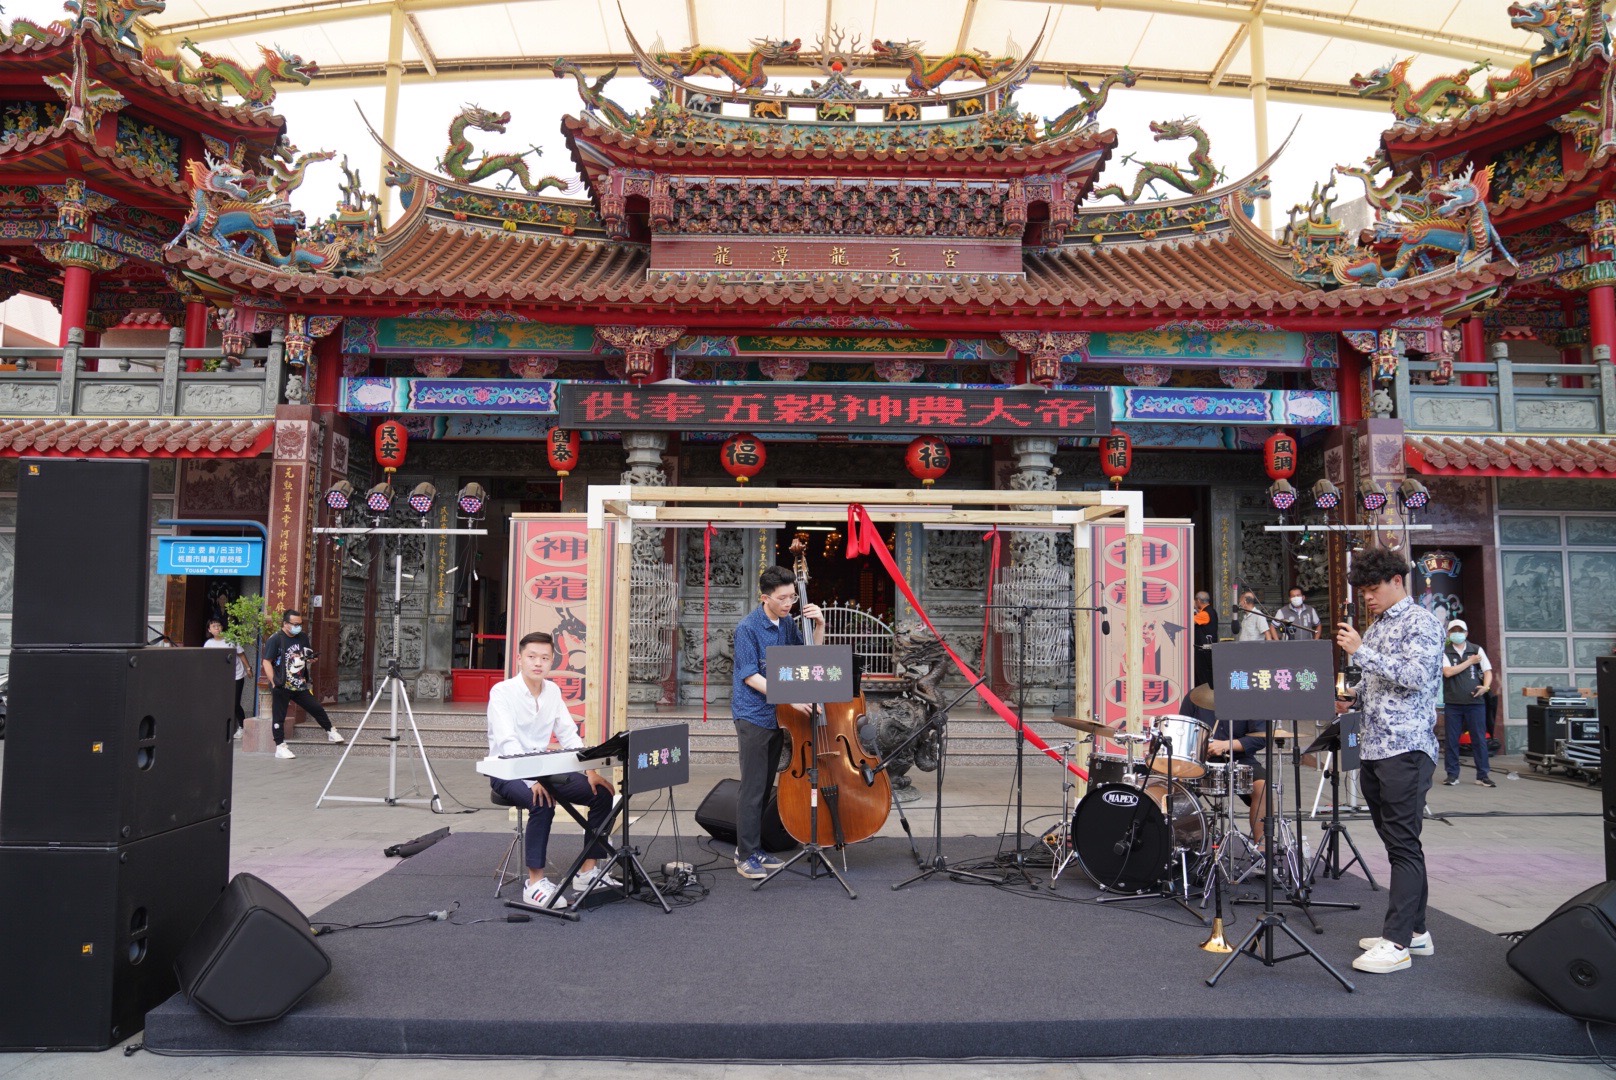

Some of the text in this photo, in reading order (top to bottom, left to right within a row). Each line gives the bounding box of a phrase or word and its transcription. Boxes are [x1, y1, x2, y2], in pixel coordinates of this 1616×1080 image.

[713, 244, 960, 269] 龍潭龍元宮
[579, 391, 1096, 427] 供奉五穀神農大帝
[380, 426, 400, 459] 民安
[552, 430, 573, 462] 國泰
[726, 439, 760, 466] 福
[918, 441, 950, 469] 福
[1106, 436, 1127, 468] 雨順
[1274, 440, 1293, 470] 風調
[779, 665, 842, 682] 龍潭愛樂
[1230, 669, 1317, 690] 龍潭愛樂
[637, 746, 681, 769] 龍潭愛樂
[1108, 793, 1135, 804] MAPEX
